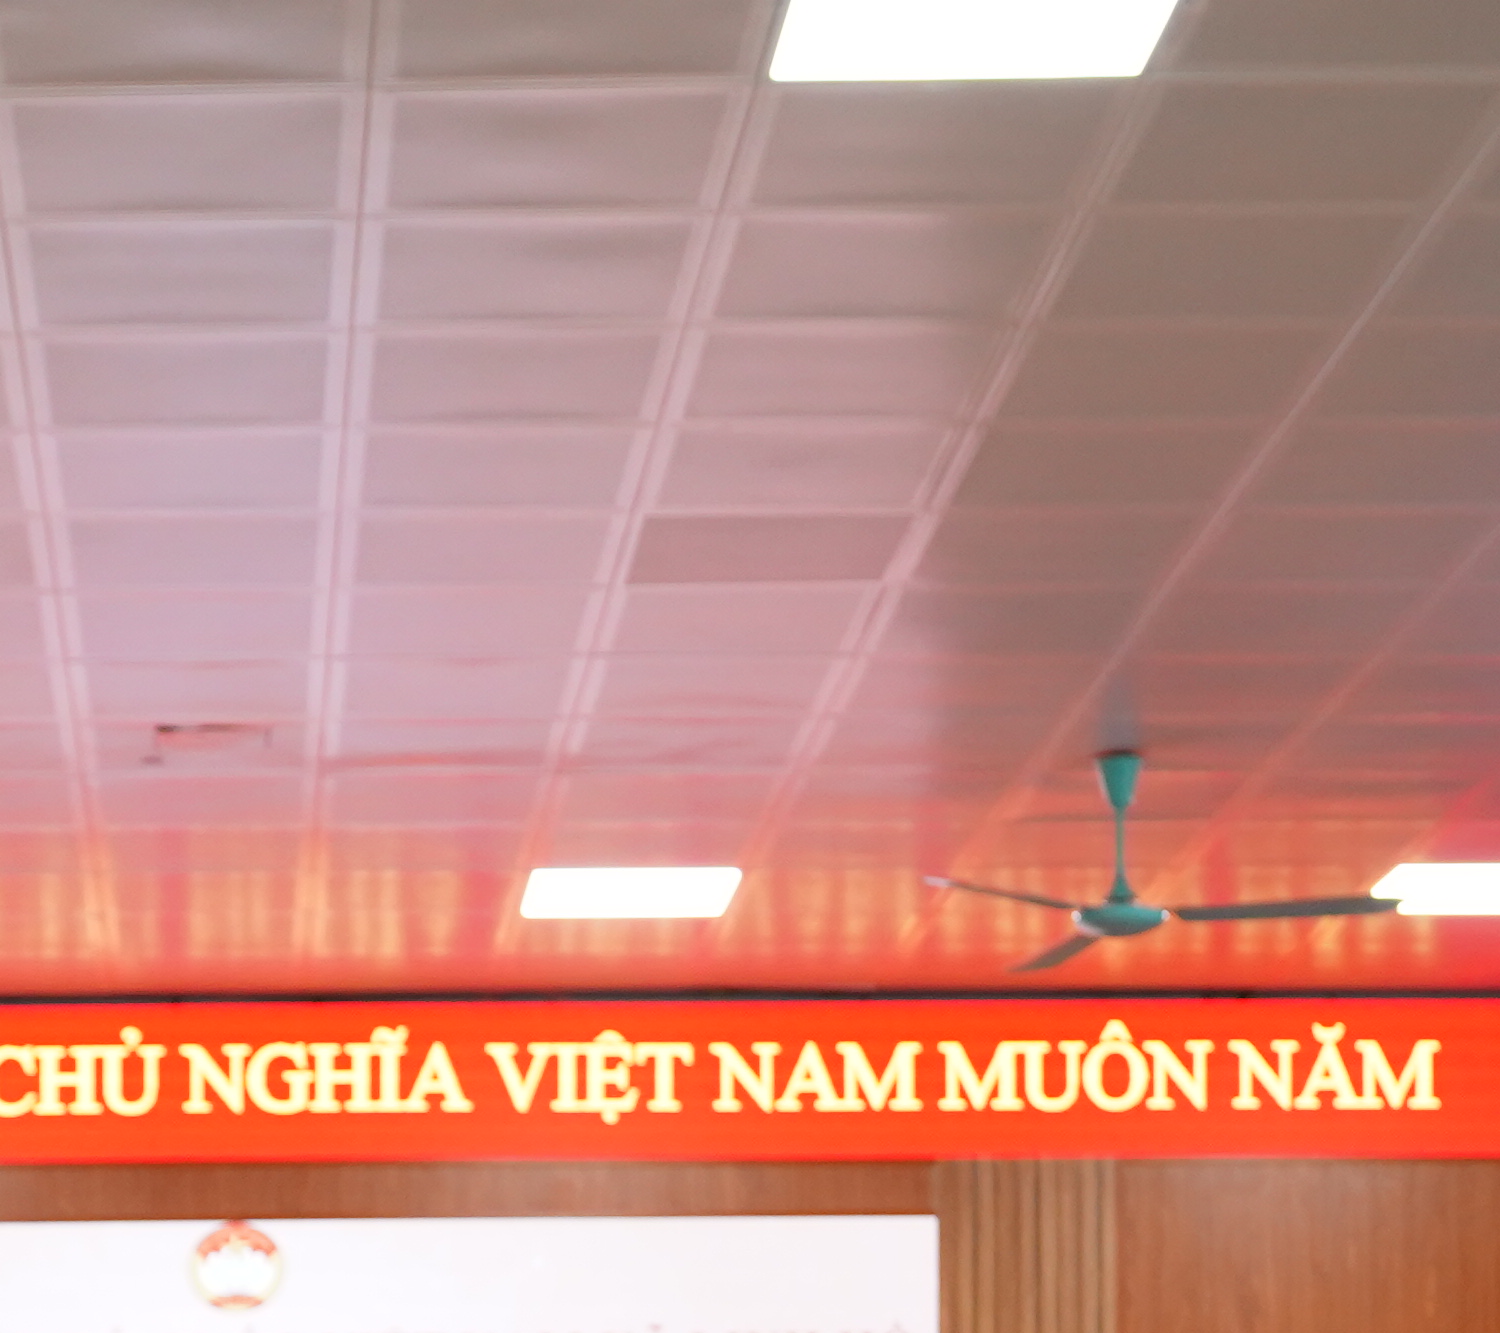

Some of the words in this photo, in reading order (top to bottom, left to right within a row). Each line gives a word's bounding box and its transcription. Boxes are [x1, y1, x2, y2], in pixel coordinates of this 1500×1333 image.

[178, 1025, 474, 1115] NGHĨA
[484, 1029, 695, 1125] VIỆT
[708, 1041, 923, 1113] NAM
[937, 1019, 1215, 1112] MUÔN
[1228, 1022, 1441, 1111] NĂM
